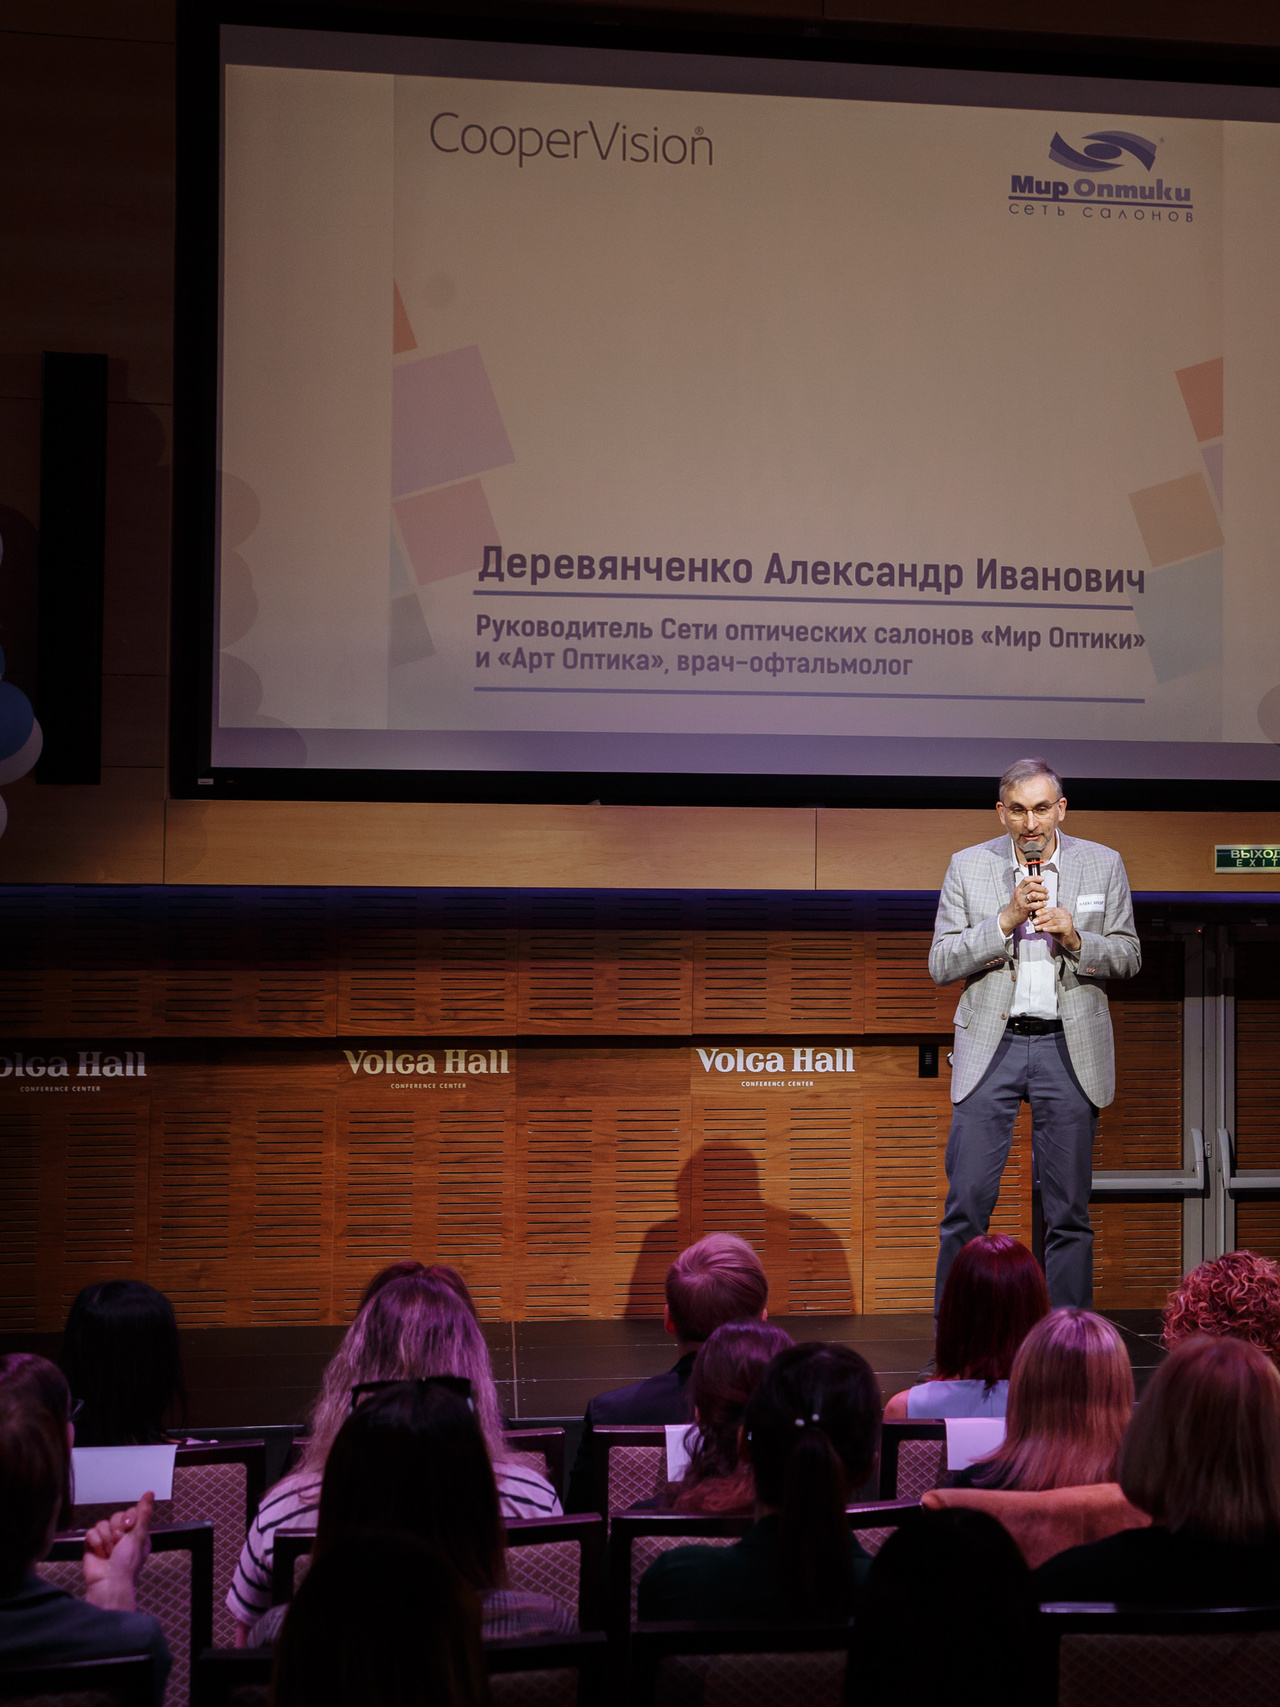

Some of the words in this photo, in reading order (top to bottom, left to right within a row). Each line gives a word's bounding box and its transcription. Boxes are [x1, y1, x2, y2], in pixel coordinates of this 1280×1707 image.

[478, 545, 753, 585] Деревянченко
[763, 552, 964, 595] Александр
[976, 558, 1145, 594] Иванович
[476, 614, 653, 642] Руководитель
[661, 617, 718, 641] Сети
[725, 621, 867, 644] оптических
[874, 625, 974, 646] салонов
[981, 625, 1041, 652] «Мир
[1049, 626, 1146, 650] Оптики»
[475, 650, 490, 669] и
[498, 647, 555, 674] «Арт
[562, 648, 670, 675] Оптика»,
[1236, 858, 1278, 867] EXIT
[0, 1052, 70, 1078] olga
[76, 1051, 148, 1078] Hall
[343, 1050, 437, 1075] Volga
[443, 1049, 510, 1074] Hall
[695, 1048, 786, 1073] Volga
[791, 1048, 856, 1073] Hall
